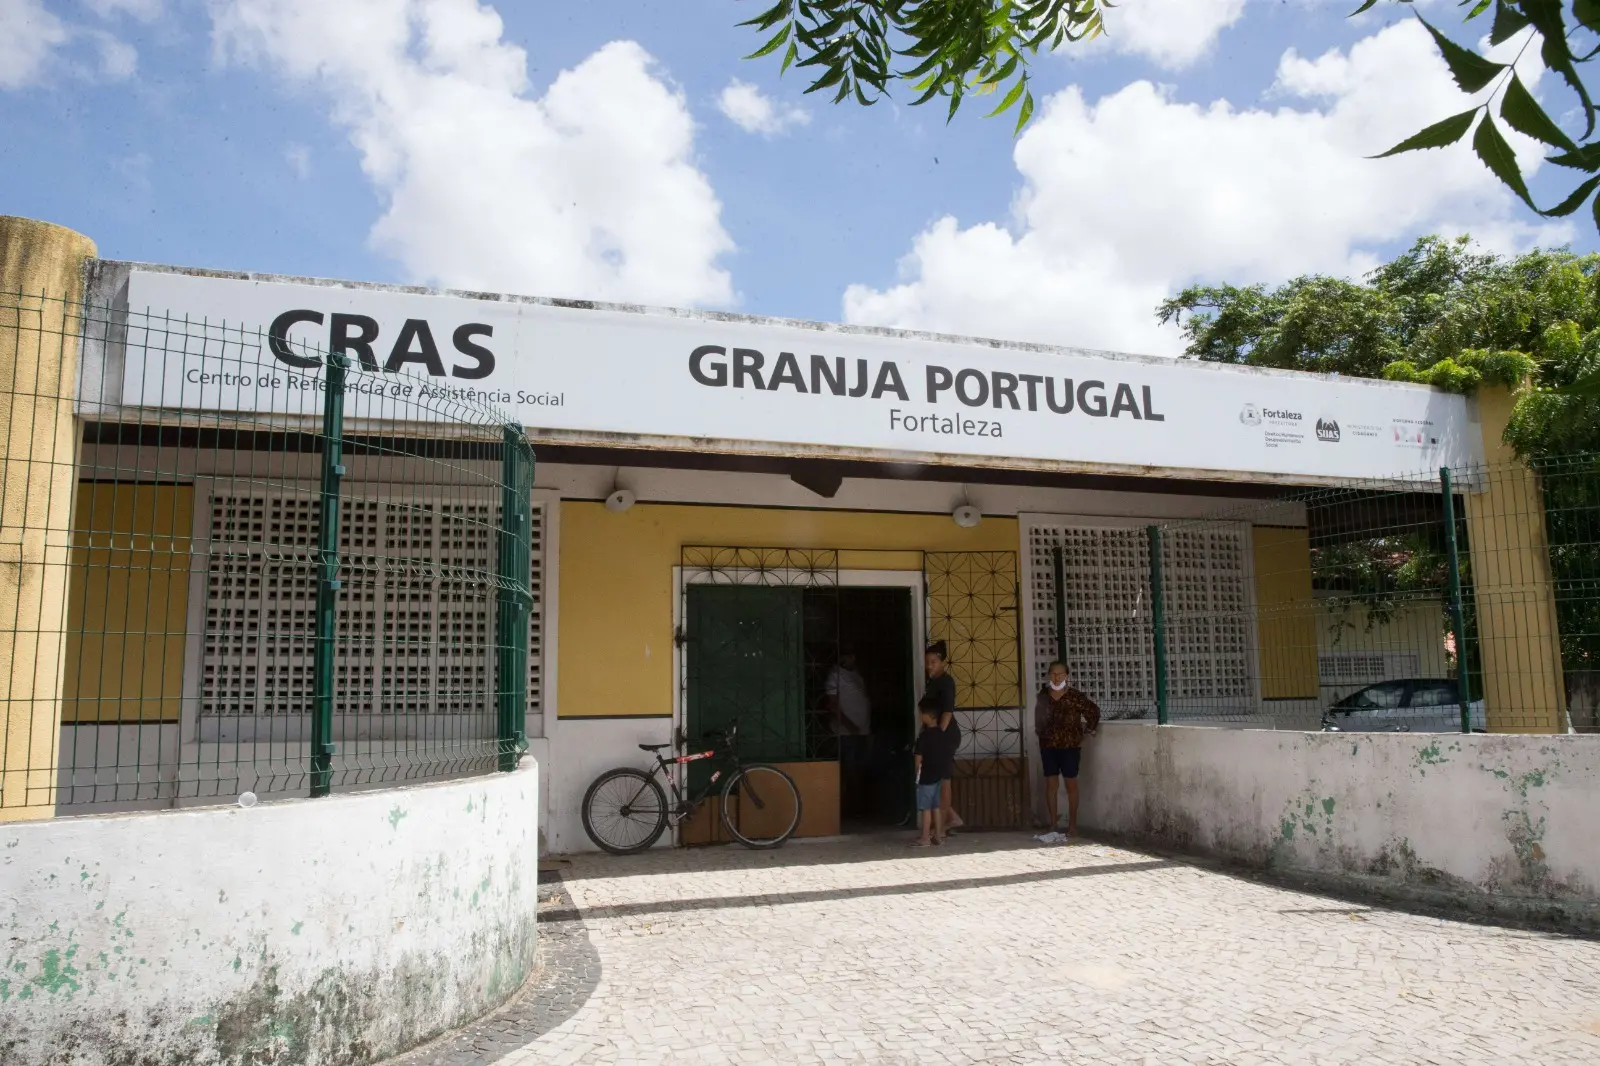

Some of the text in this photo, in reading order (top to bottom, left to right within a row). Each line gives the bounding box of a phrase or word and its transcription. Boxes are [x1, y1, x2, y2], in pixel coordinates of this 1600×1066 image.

[269, 309, 496, 380] CRAS
[187, 369, 564, 407] Centro de Refencia de Assistência Social
[688, 345, 1165, 422] GRANJA PORTUGAL
[890, 409, 1003, 438] Fortaleza
[1263, 408, 1302, 420] Fortaleza
[1317, 429, 1340, 439] SUAS
